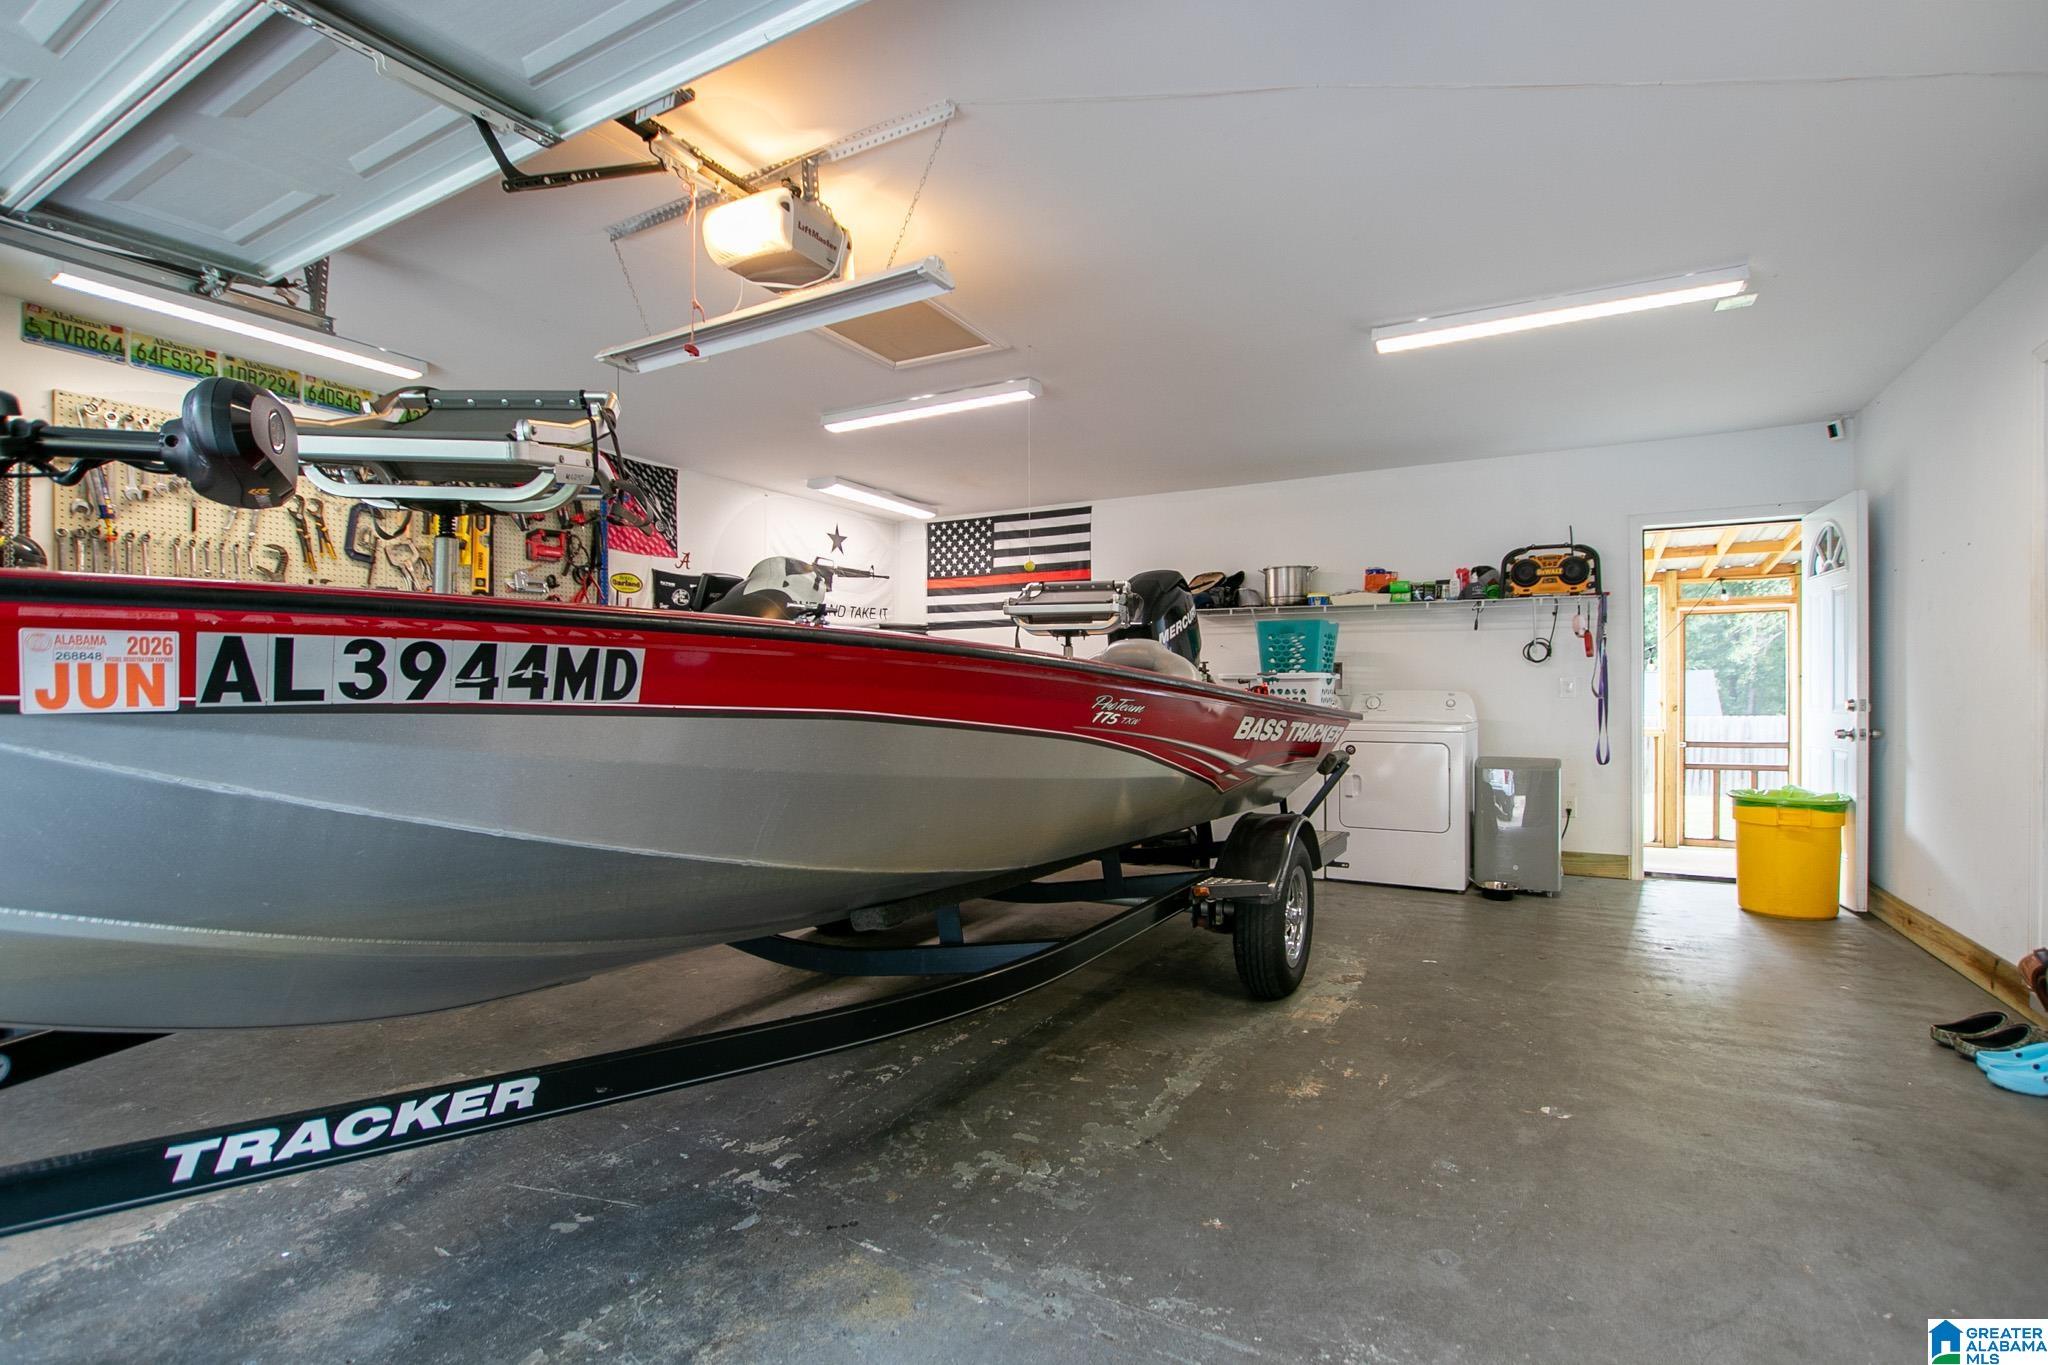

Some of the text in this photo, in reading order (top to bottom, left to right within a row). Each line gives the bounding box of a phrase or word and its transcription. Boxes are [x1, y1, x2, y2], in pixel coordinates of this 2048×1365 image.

[797, 219, 838, 252] LiftMaster
[51, 309, 103, 330] Alabama
[48, 319, 125, 354] TVR864
[152, 337, 198, 355] Alabama
[136, 342, 217, 379] 64FS325
[308, 384, 370, 412] 64DS43
[849, 605, 876, 620] TAKE
[879, 607, 888, 620] IT
[54, 633, 174, 656] ALABAMA 2026
[55, 651, 102, 661] 268848
[34, 661, 166, 710] JUN
[1092, 711, 1121, 725] 175
[1233, 716, 1345, 743] BASS TRACKER
[164, 1076, 540, 1184] TRACKER
